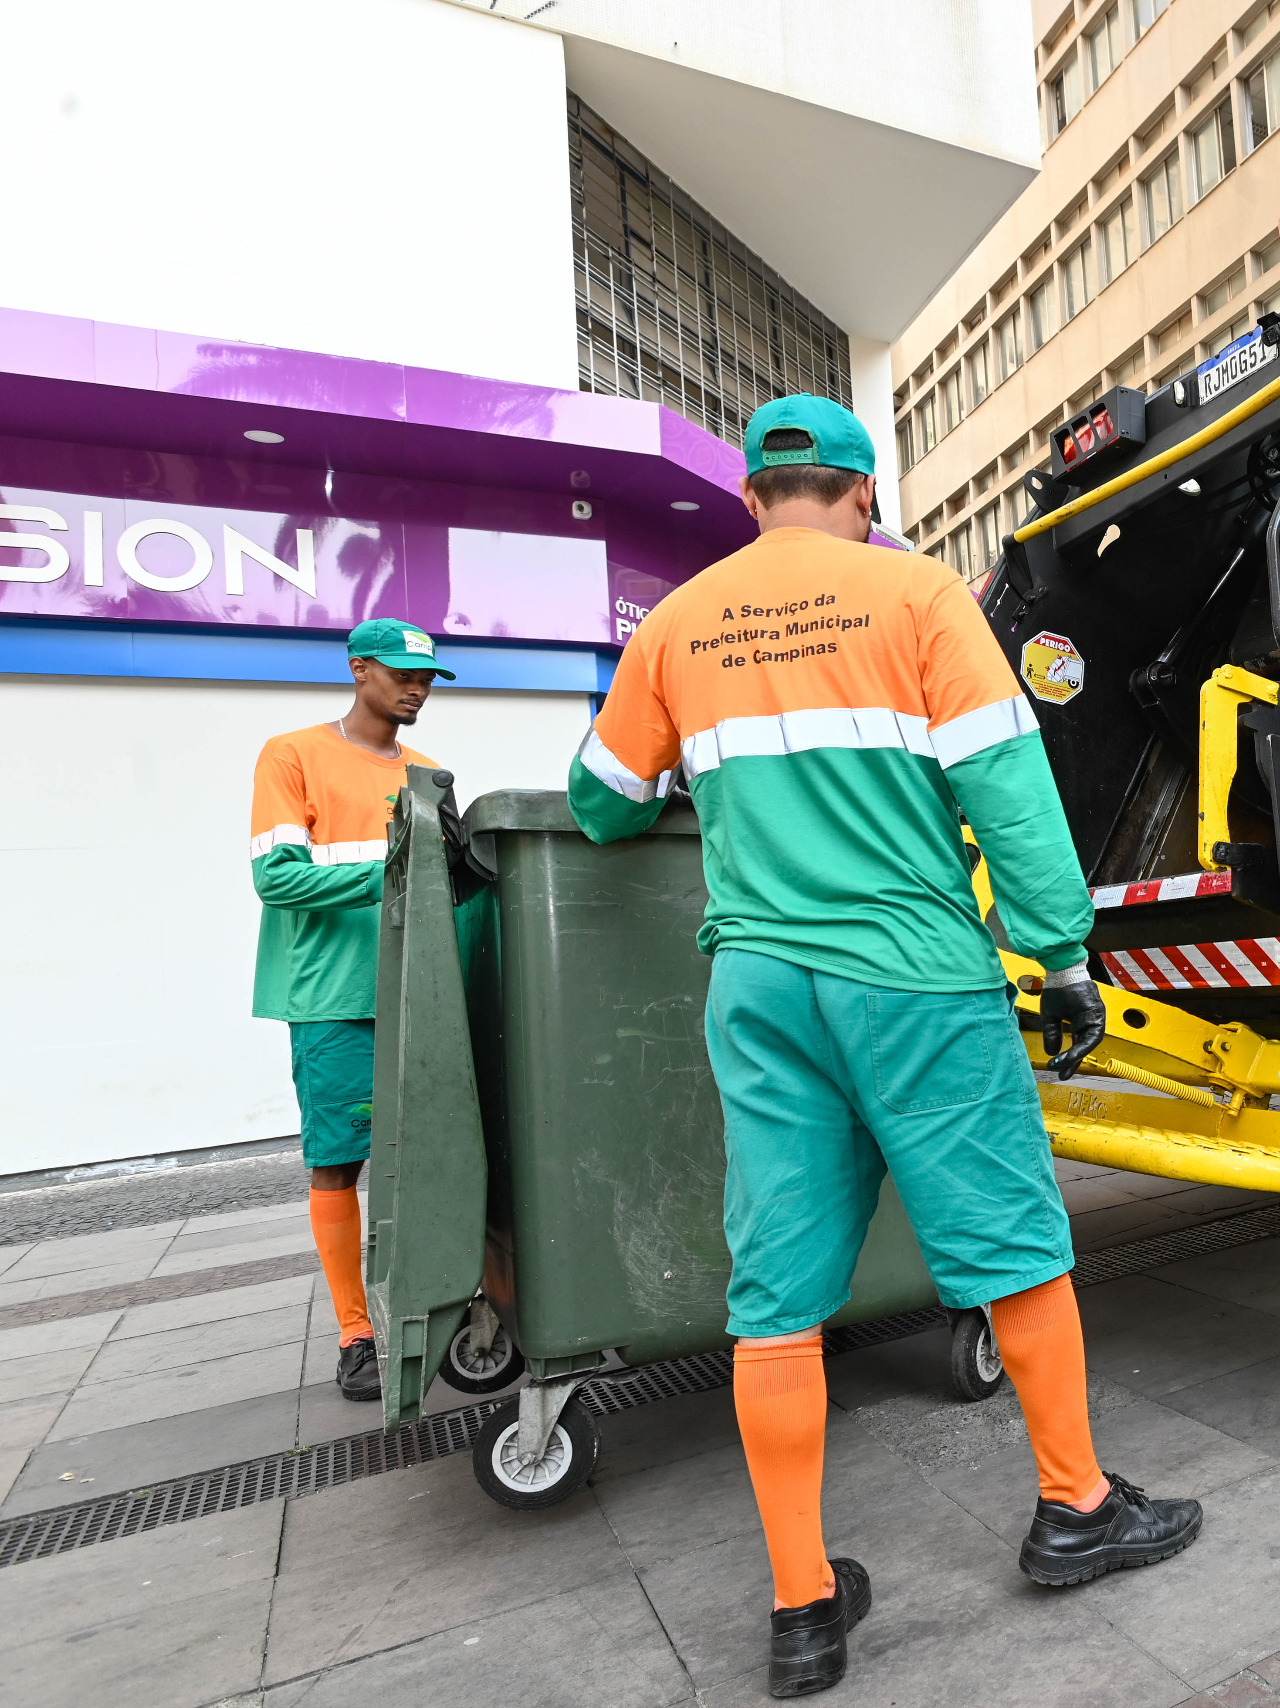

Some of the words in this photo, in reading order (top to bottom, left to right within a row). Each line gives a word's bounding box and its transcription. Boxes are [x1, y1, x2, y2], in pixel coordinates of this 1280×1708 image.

[721, 607, 735, 622] A
[740, 599, 809, 618] Serviço
[814, 593, 836, 607] da
[690, 628, 780, 655] Prefeitura
[785, 614, 870, 638] Municipal
[1040, 636, 1071, 653] PERIGO
[721, 654, 746, 668] de
[753, 641, 838, 664] Campinas
